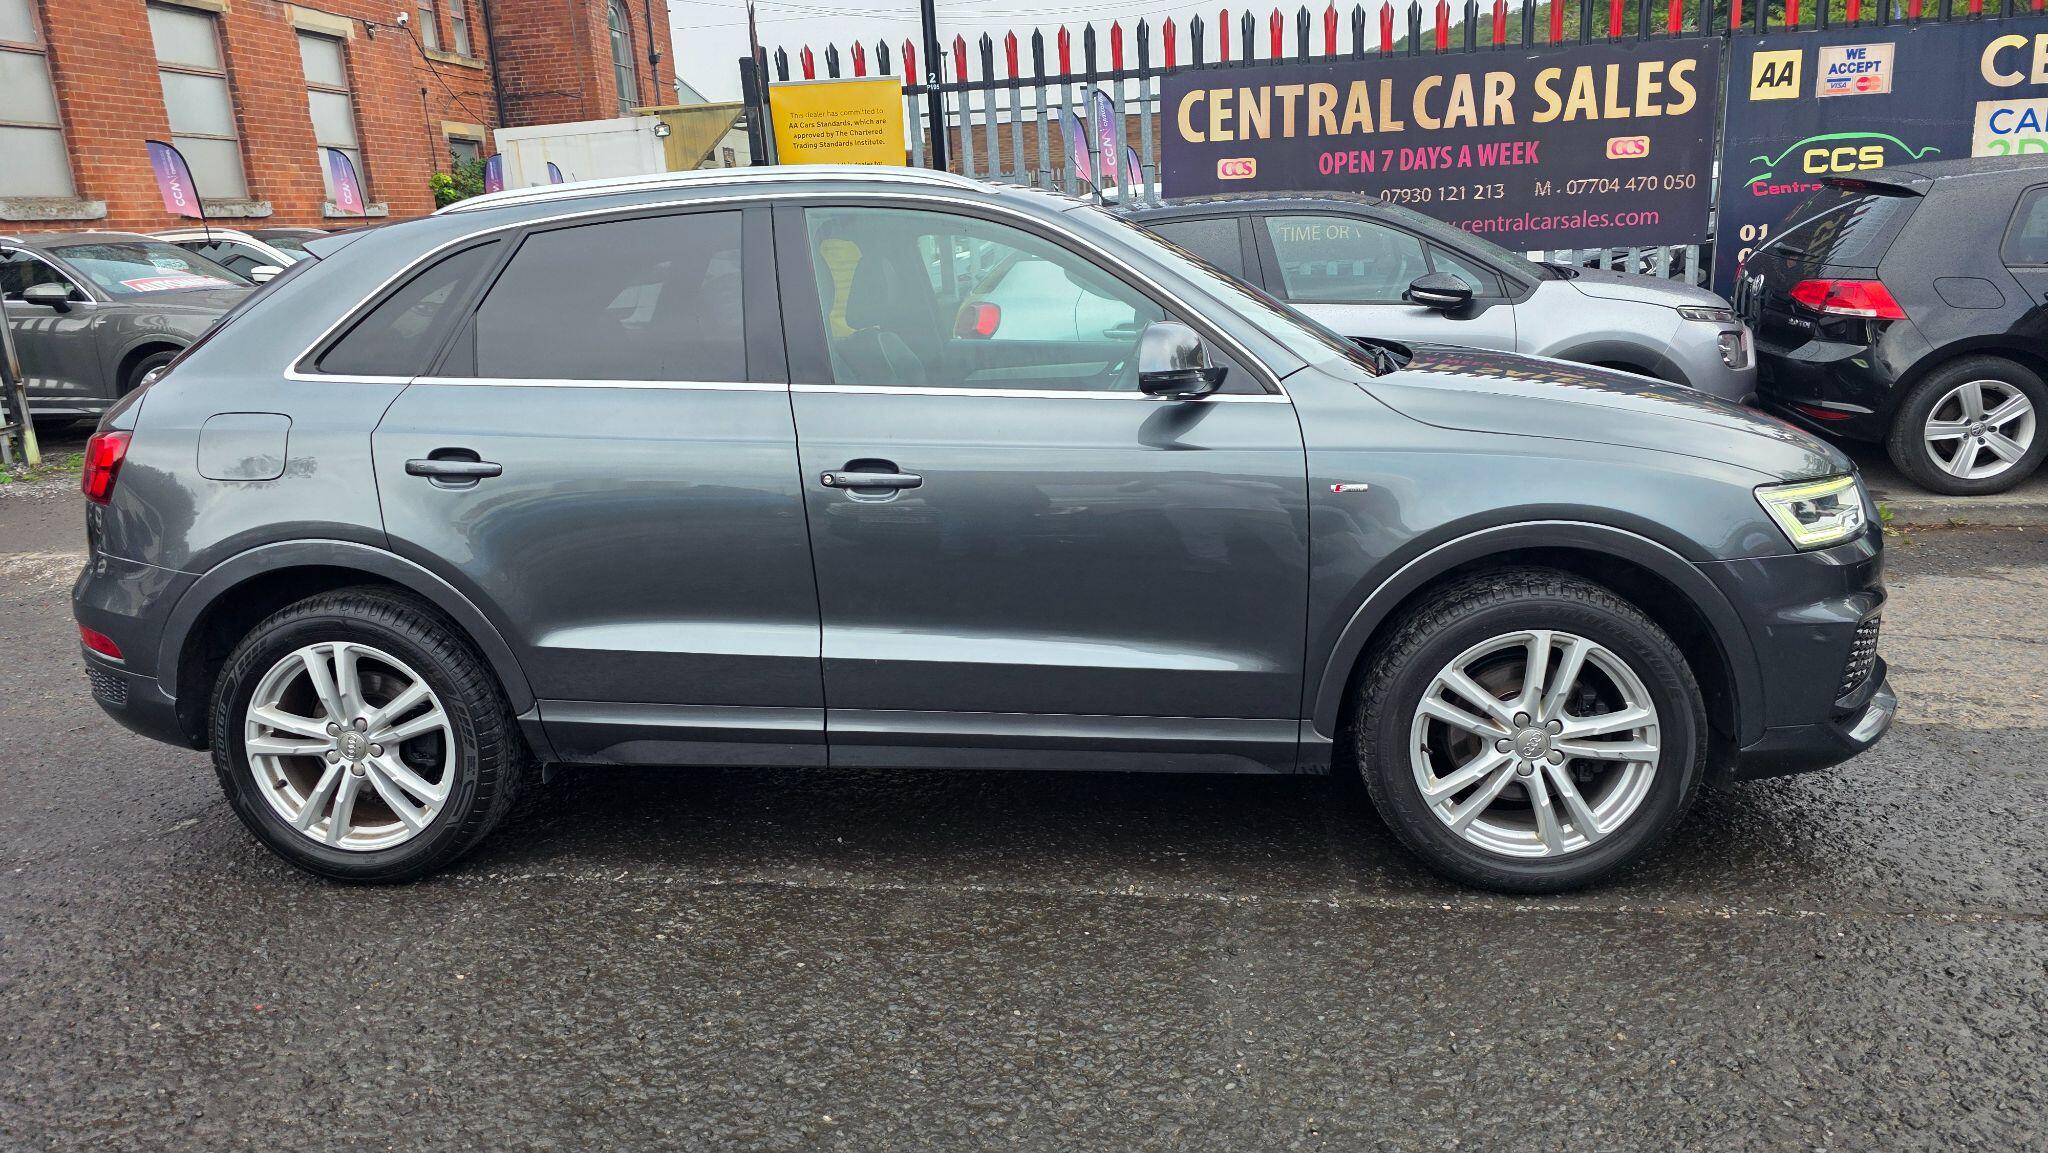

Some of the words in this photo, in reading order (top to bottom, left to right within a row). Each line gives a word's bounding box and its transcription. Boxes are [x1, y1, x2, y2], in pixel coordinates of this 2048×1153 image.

[1846, 48, 1866, 60] WE
[1757, 60, 1794, 88] AA
[1828, 61, 1882, 75] ACCEPT
[928, 72, 937, 84] 2
[1177, 79, 1406, 143] CENTRAL
[1412, 71, 1516, 130] CAR
[1532, 59, 1697, 123] SALES
[840, 108, 875, 116] committed
[1989, 107, 2048, 135] CA
[793, 132, 825, 140] approved
[826, 131, 835, 139] by
[793, 142, 818, 150] Trading
[819, 140, 853, 148] Standards
[1611, 138, 1646, 156] CCS
[1319, 151, 1375, 175] OPEN
[1381, 150, 1395, 172] 7
[1400, 146, 1453, 171] DAYS
[1457, 143, 1472, 168] A
[1477, 141, 1541, 166] WEEK
[1803, 146, 1884, 174] CCS
[1220, 160, 1254, 177] CCS
[1380, 187, 1432, 204] 07930
[1438, 186, 1465, 201] 121
[1474, 184, 1505, 200] 213
[1534, 181, 1551, 197] M
[1566, 178, 1620, 195] 07704
[1625, 176, 1657, 192] 470
[1664, 174, 1696, 190] 050
